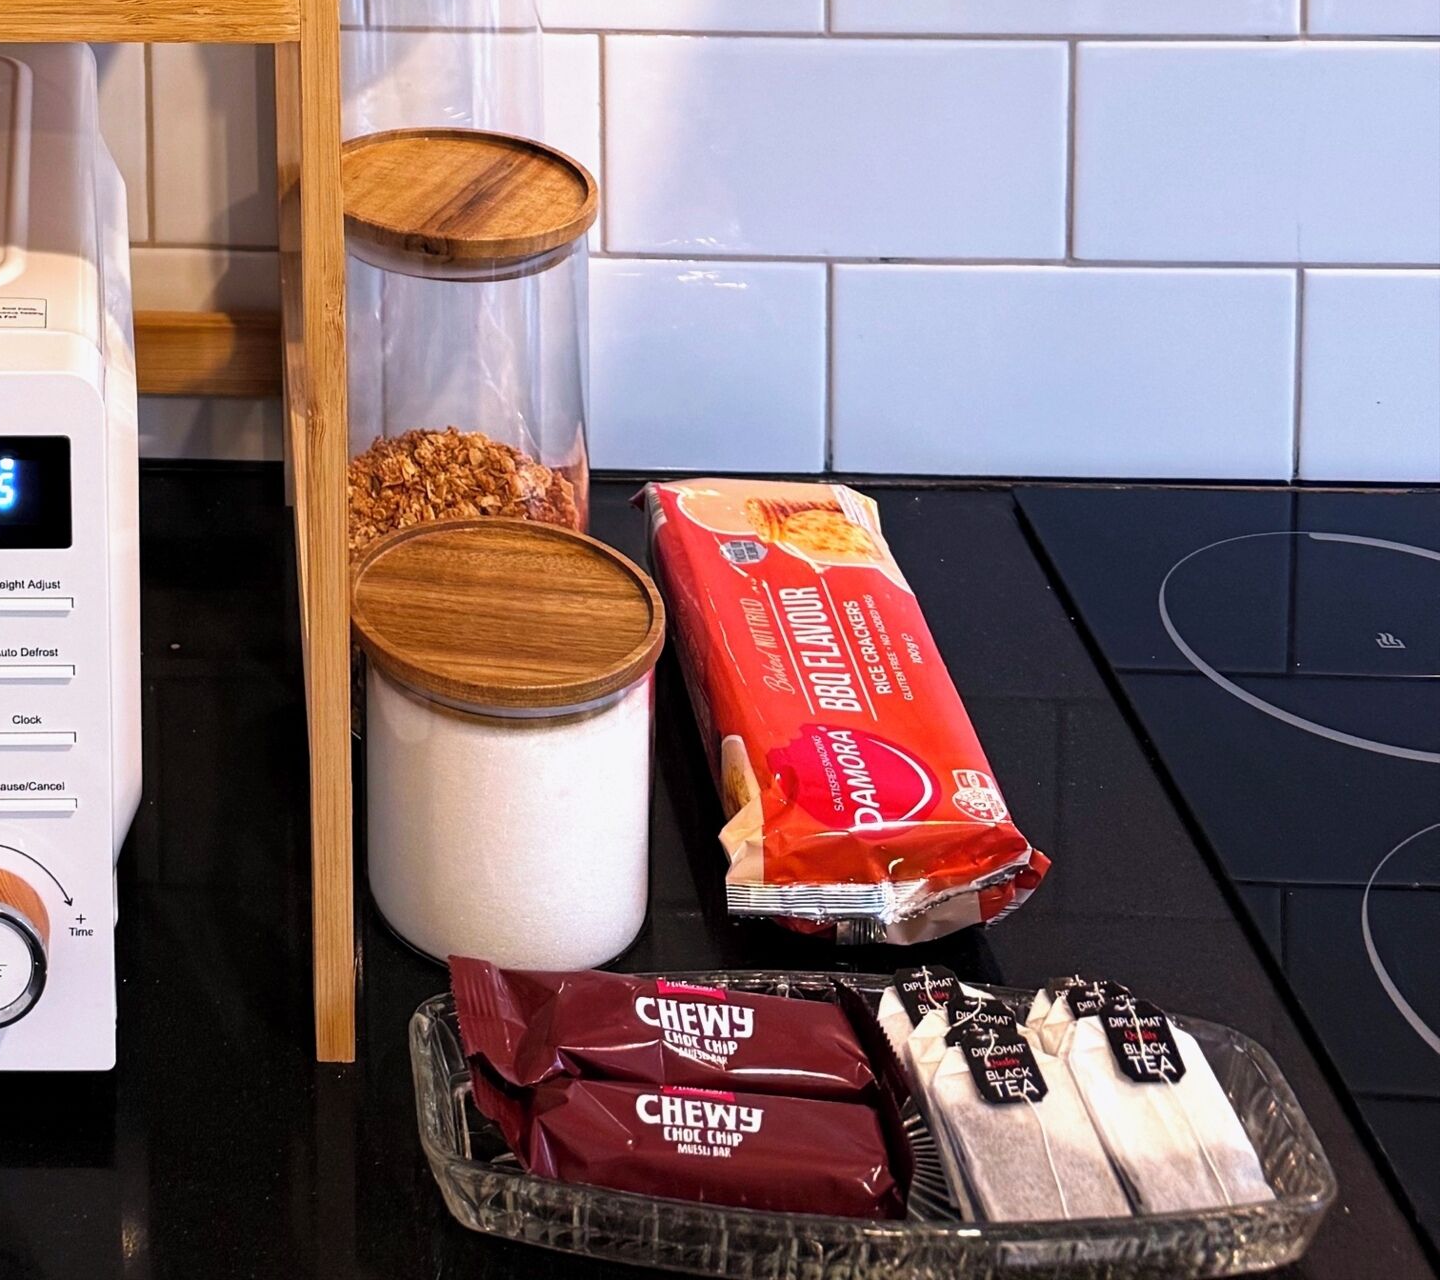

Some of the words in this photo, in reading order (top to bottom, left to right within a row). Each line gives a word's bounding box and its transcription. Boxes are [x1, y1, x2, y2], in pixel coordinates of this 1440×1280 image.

[27, 579, 61, 592] Adjust
[863, 594, 877, 609] MSG
[778, 586, 846, 669] FLAVOUR
[870, 609, 888, 634] ADDED
[843, 600, 880, 664] CRACKERS
[880, 634, 892, 646] NO
[20, 647, 59, 657] Defrost
[886, 651, 902, 671] FREE
[756, 647, 795, 695] Baked
[867, 664, 893, 695] RICE
[809, 672, 863, 713] BBQ
[894, 670, 914, 701] GLUTEN
[12, 714, 42, 725] Clock
[811, 735, 833, 768] SNACKING
[824, 767, 845, 812] SATISFIED
[827, 730, 884, 831] DAMORA
[68, 926, 94, 937] Time
[635, 996, 755, 1038] CHEWY
[664, 1029, 701, 1049] CHOC
[1123, 1042, 1171, 1055] BLACK
[985, 1066, 1033, 1082] BLACK
[1128, 1054, 1178, 1074] TEA
[990, 1078, 1040, 1098] TEA
[635, 1094, 765, 1134] CHEWY
[663, 1126, 702, 1143] CHOC
[712, 1146, 732, 1158] BAR
